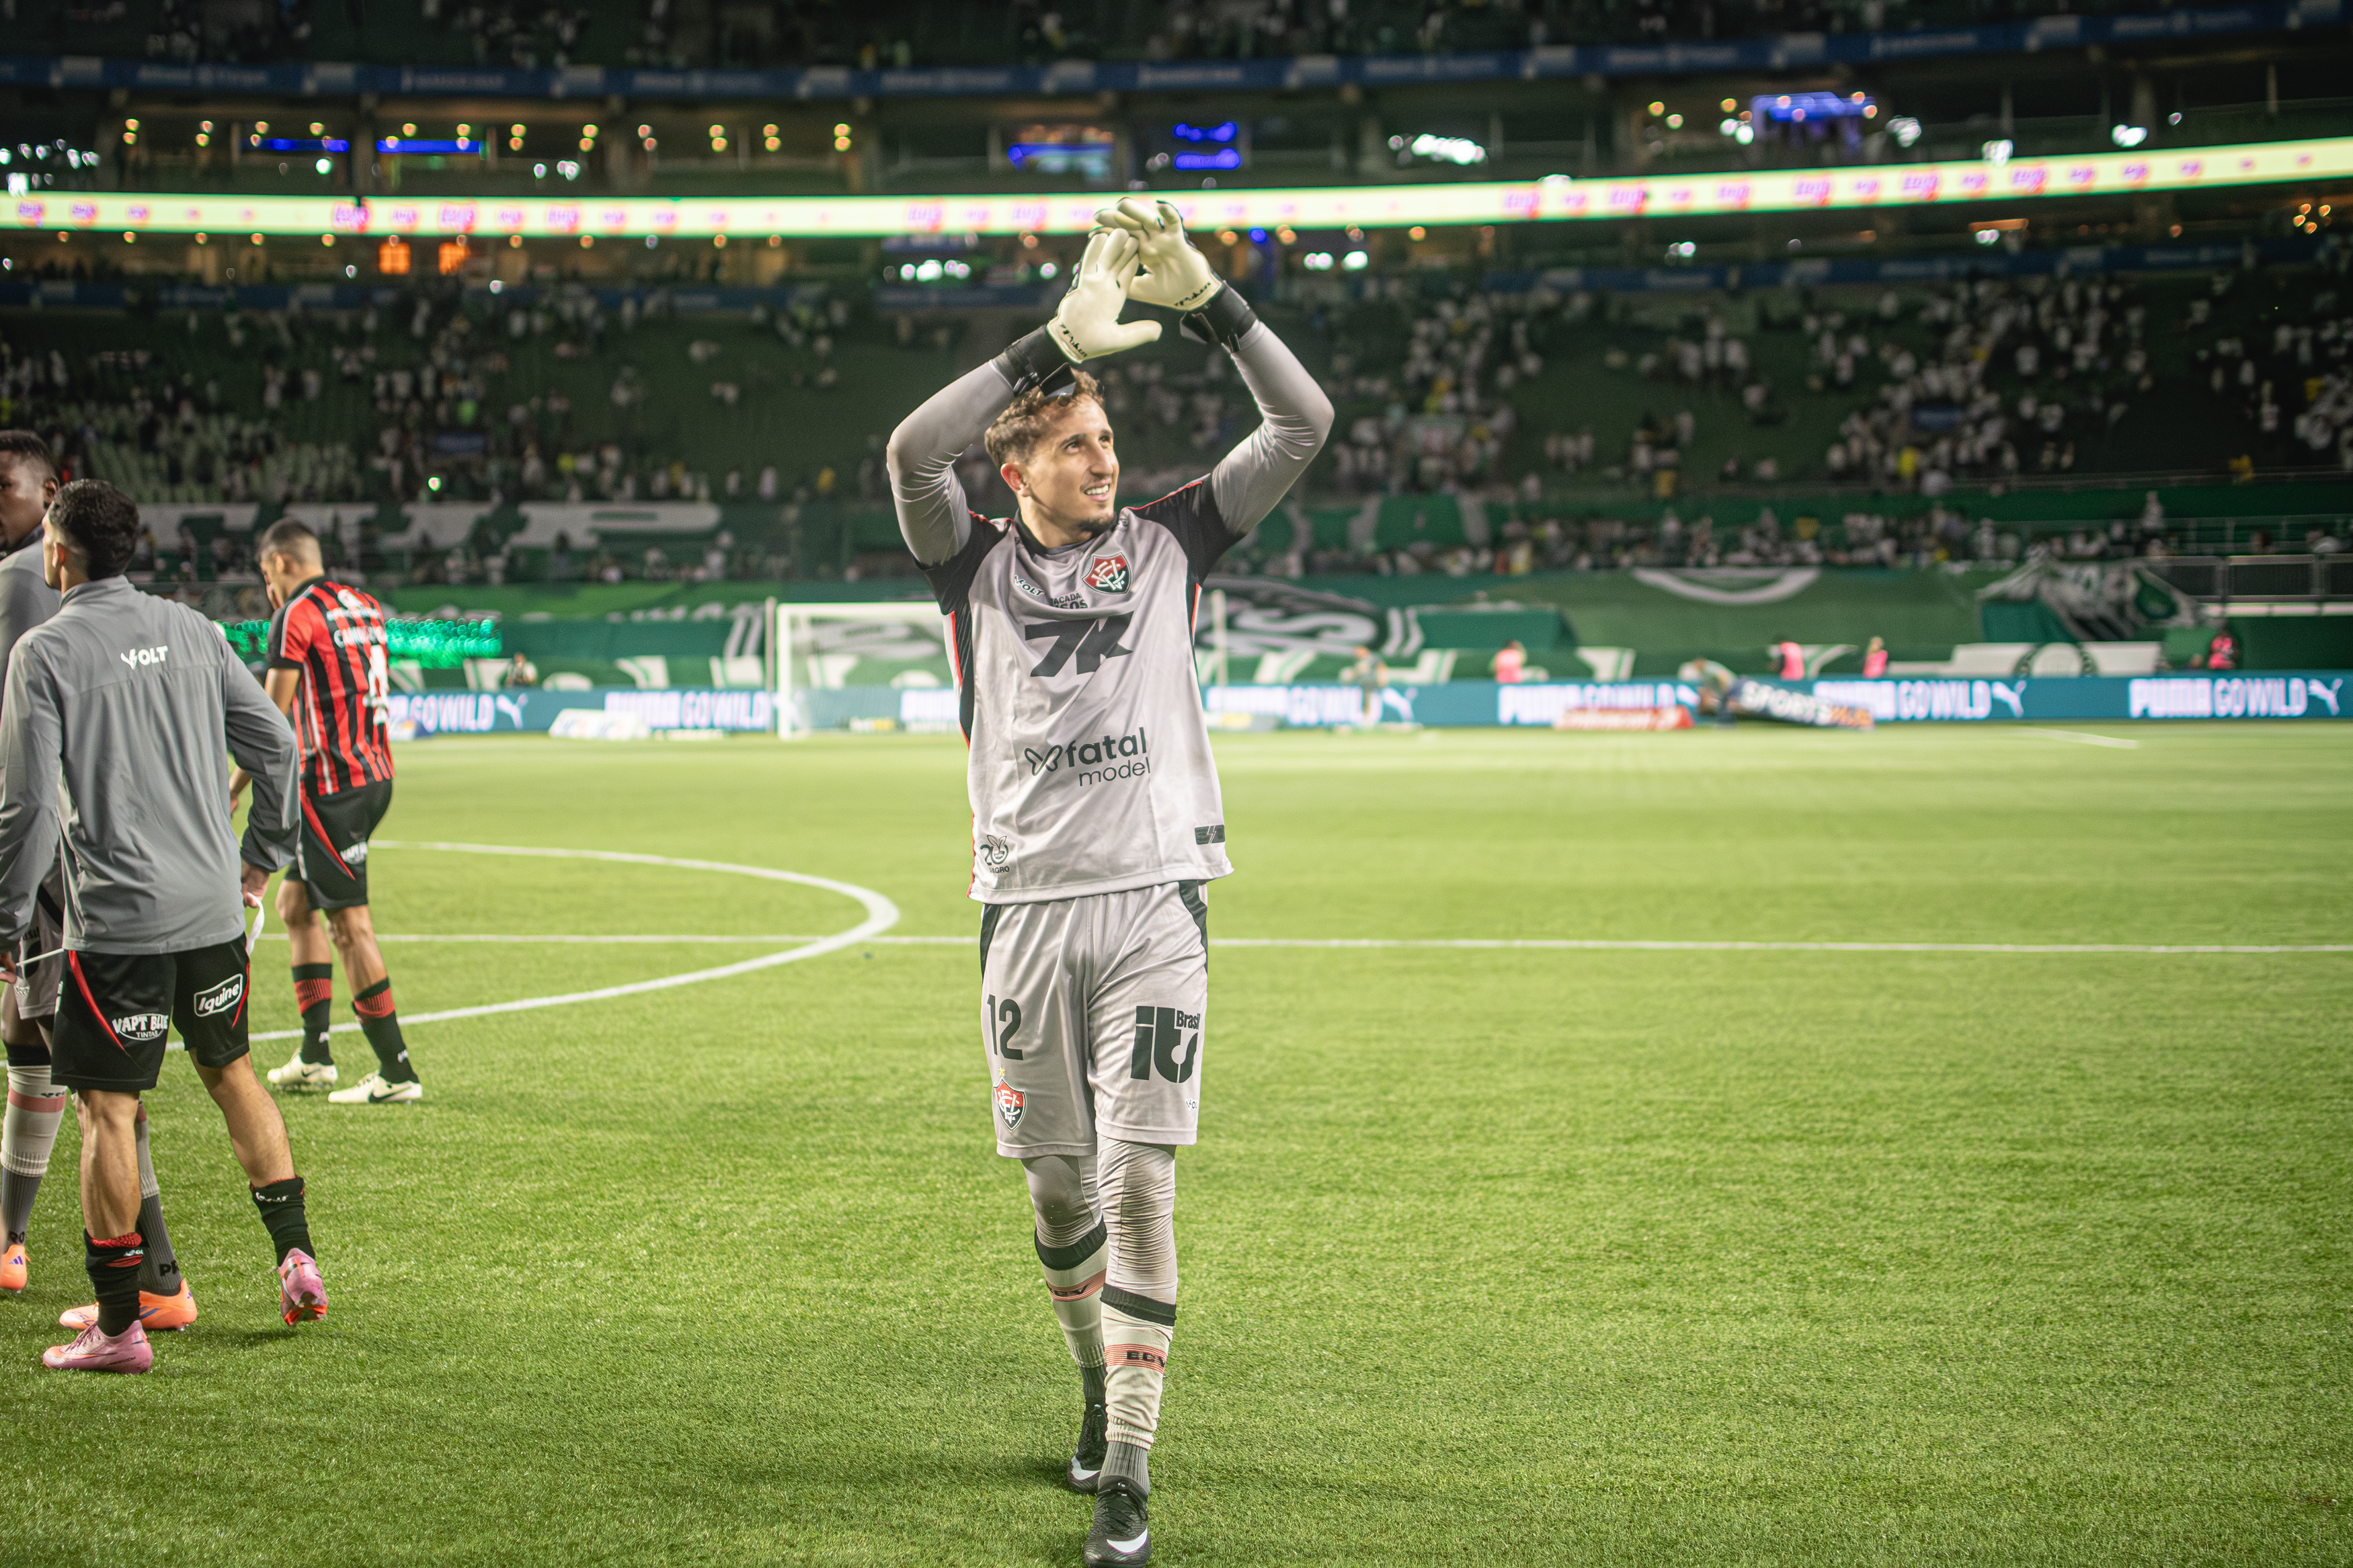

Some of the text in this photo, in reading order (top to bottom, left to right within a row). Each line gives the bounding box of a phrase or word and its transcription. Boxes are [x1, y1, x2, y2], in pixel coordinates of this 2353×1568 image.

[1014, 575, 1045, 596] VOLT
[120, 645, 168, 670] VOLT
[1066, 727, 1147, 768] fatal
[1078, 756, 1151, 786] model
[198, 983, 240, 1012] Iquine
[112, 1016, 148, 1034] VAPT
[136, 1030, 158, 1038] TINTAS
[987, 993, 1023, 1061] 12
